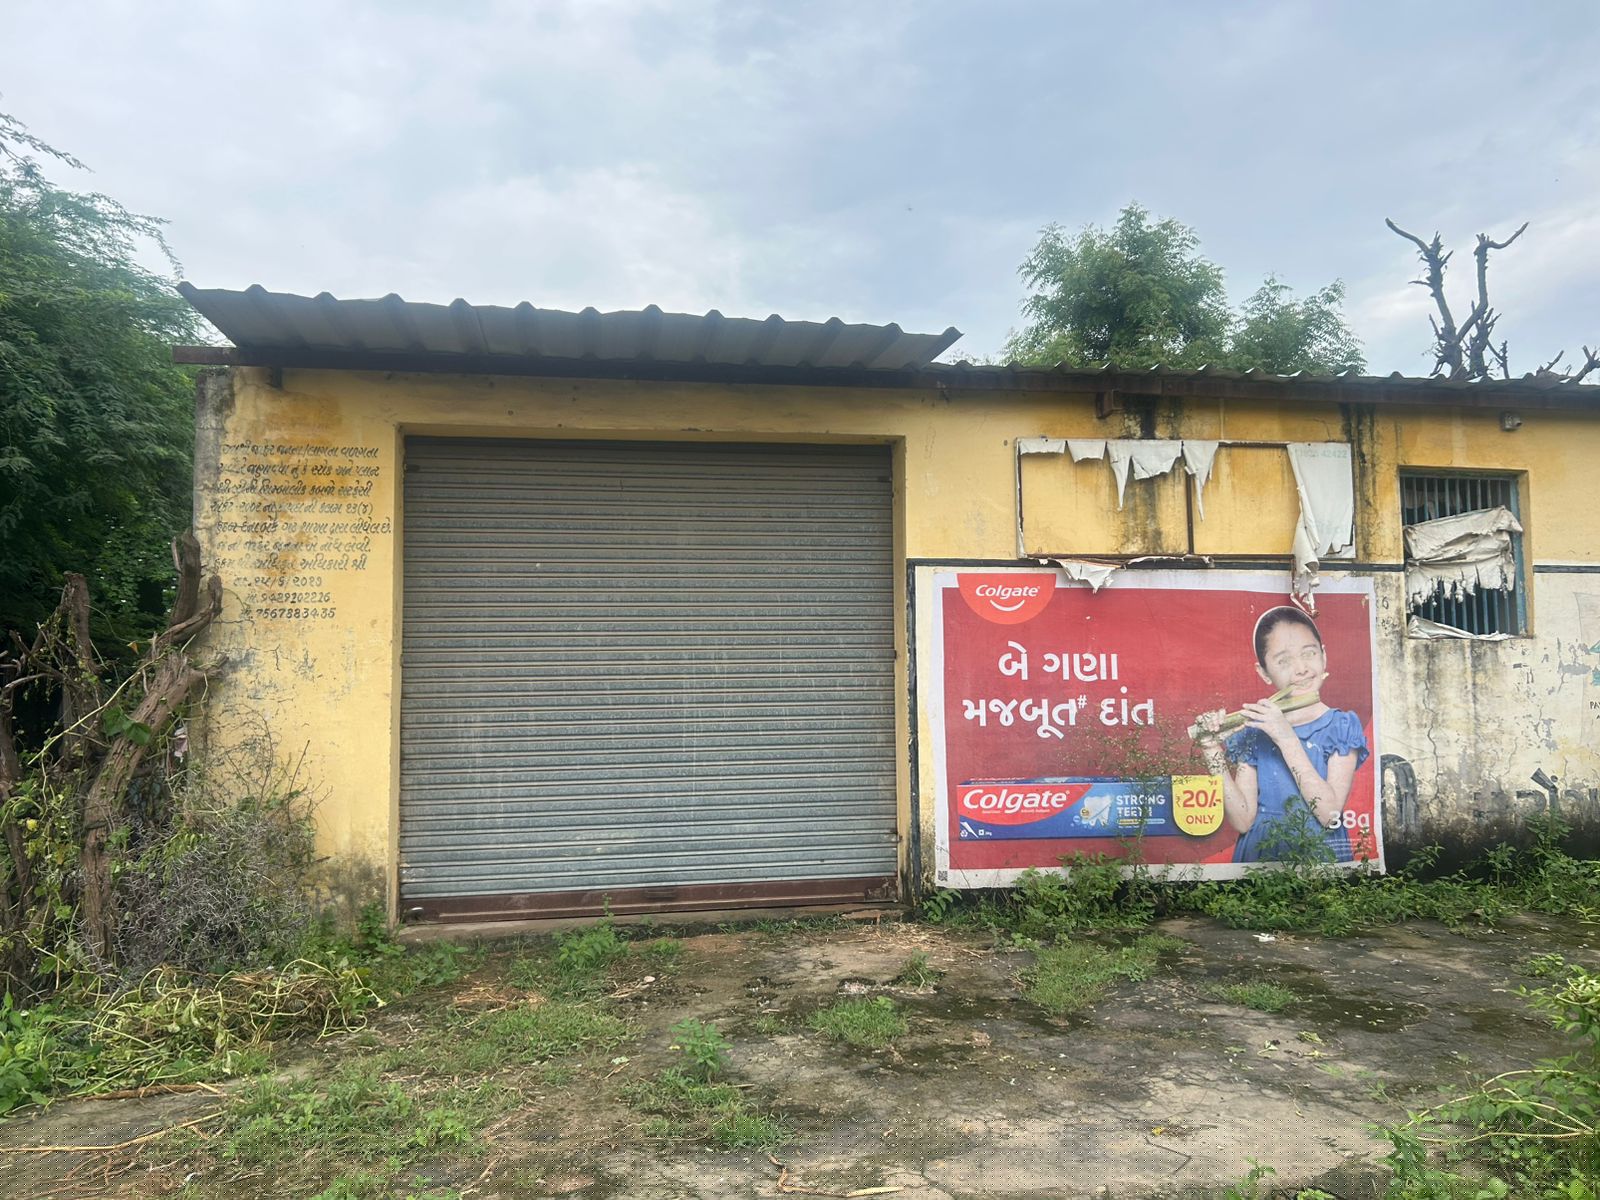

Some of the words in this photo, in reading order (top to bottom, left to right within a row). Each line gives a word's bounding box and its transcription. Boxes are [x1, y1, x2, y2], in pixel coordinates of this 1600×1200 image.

[975, 583, 1040, 600] Colgate
[998, 640, 1028, 681] બે
[1042, 651, 1119, 682] ગણા
[1098, 686, 1155, 726] દાંત
[963, 788, 1069, 814] Colgate
[1116, 794, 1166, 805] STRONG
[1186, 815, 1215, 825] ONLY
